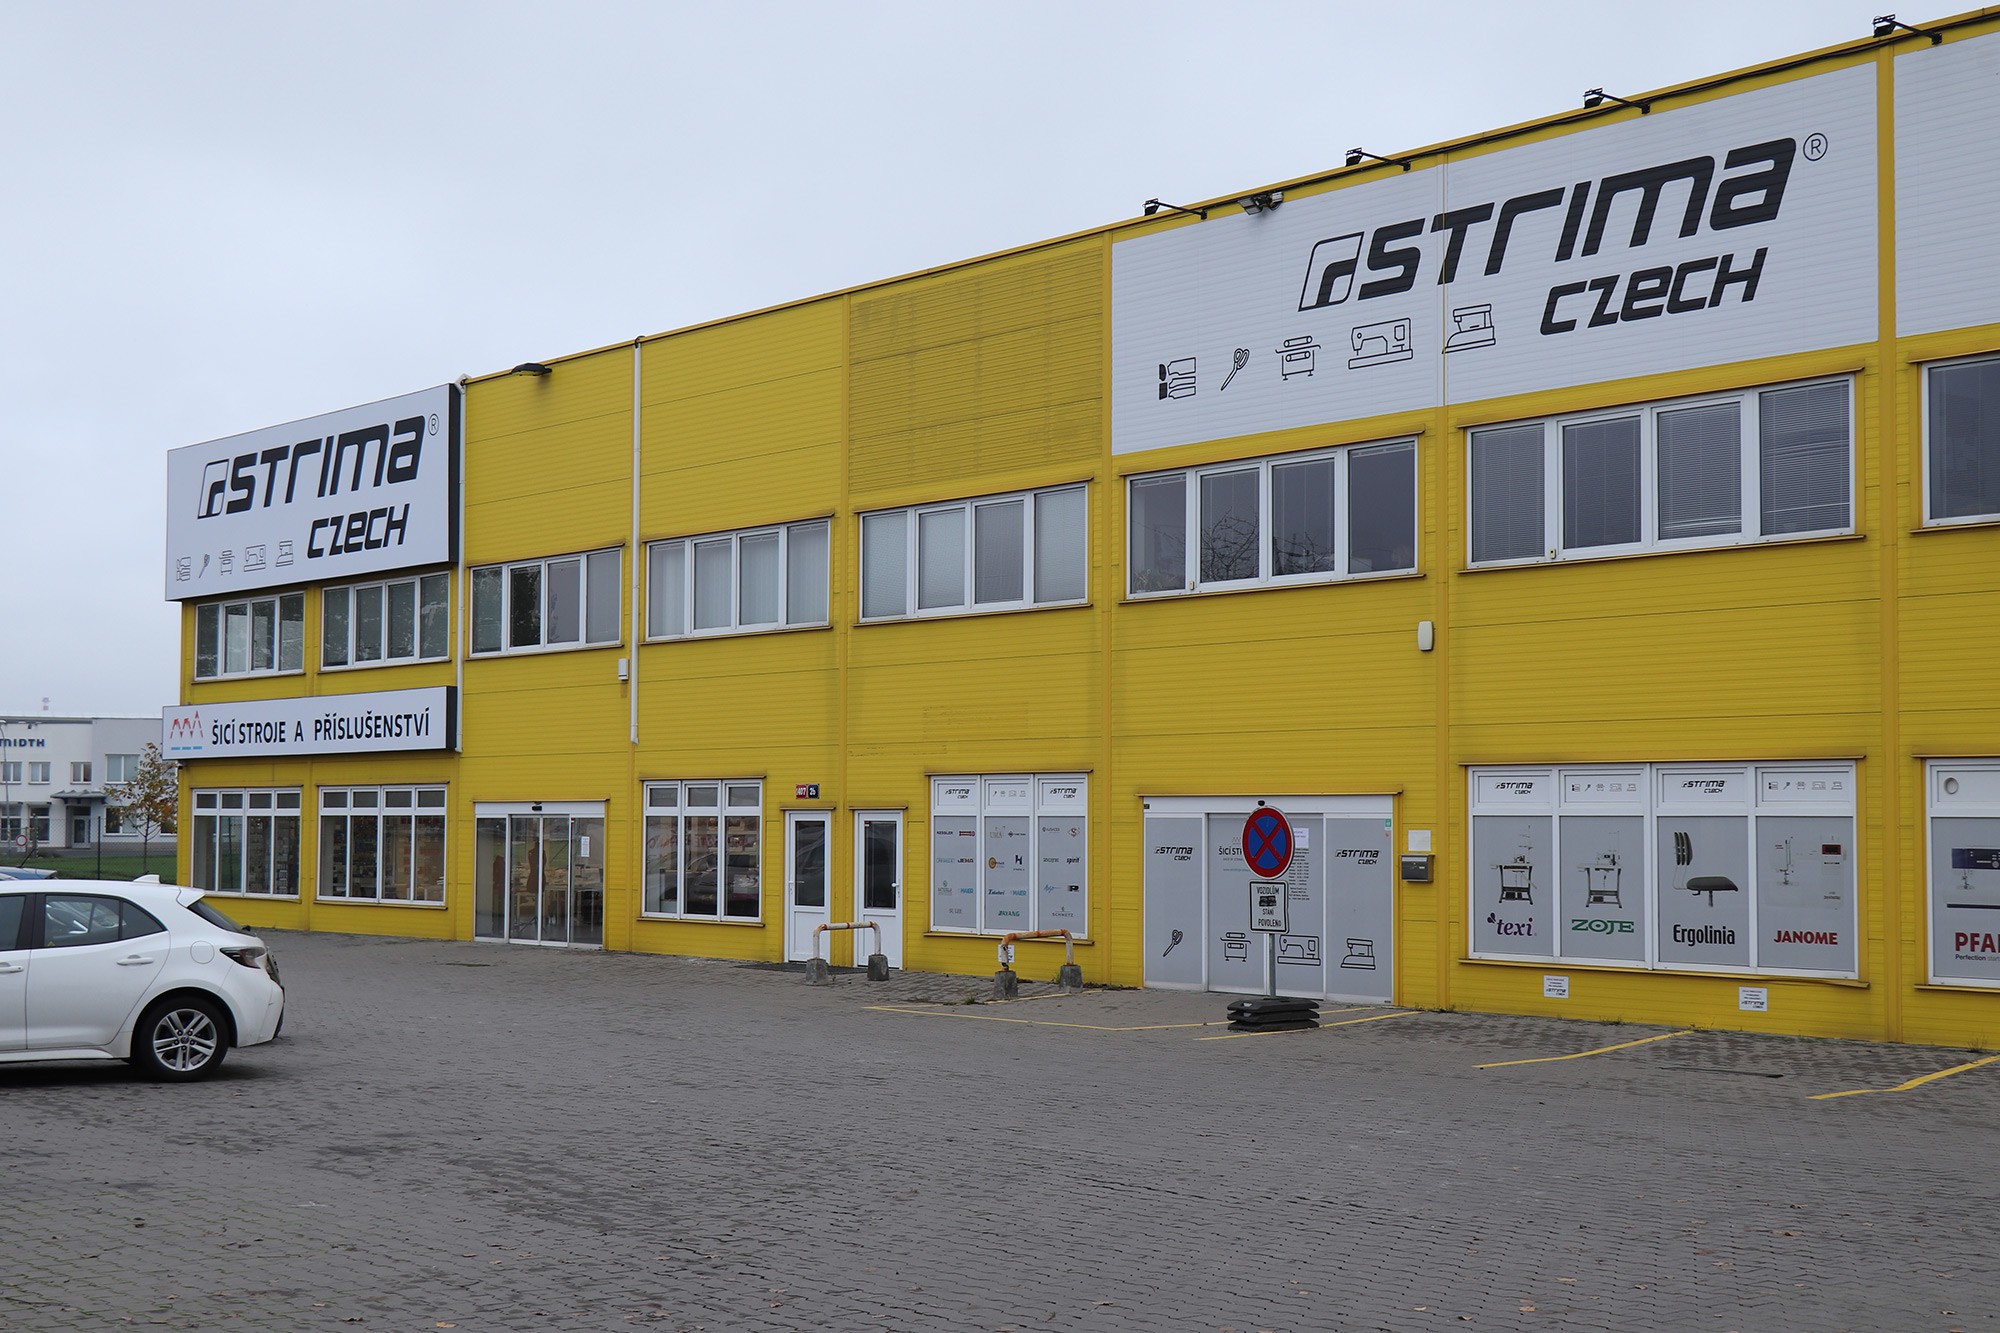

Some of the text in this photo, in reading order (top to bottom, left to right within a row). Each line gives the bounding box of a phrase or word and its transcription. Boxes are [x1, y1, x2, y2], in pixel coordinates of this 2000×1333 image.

[212, 707, 430, 745] ŠICÍ STROJE A PŘÍSLUŠENSTVÍ
[1496, 917, 1533, 937] texi
[1571, 918, 1635, 935] ZOJE
[1673, 924, 1736, 947] Ergolinia
[1773, 930, 1838, 945] JANOME
[1955, 932, 2000, 953] PFA
[1955, 953, 1986, 961] Perfection
